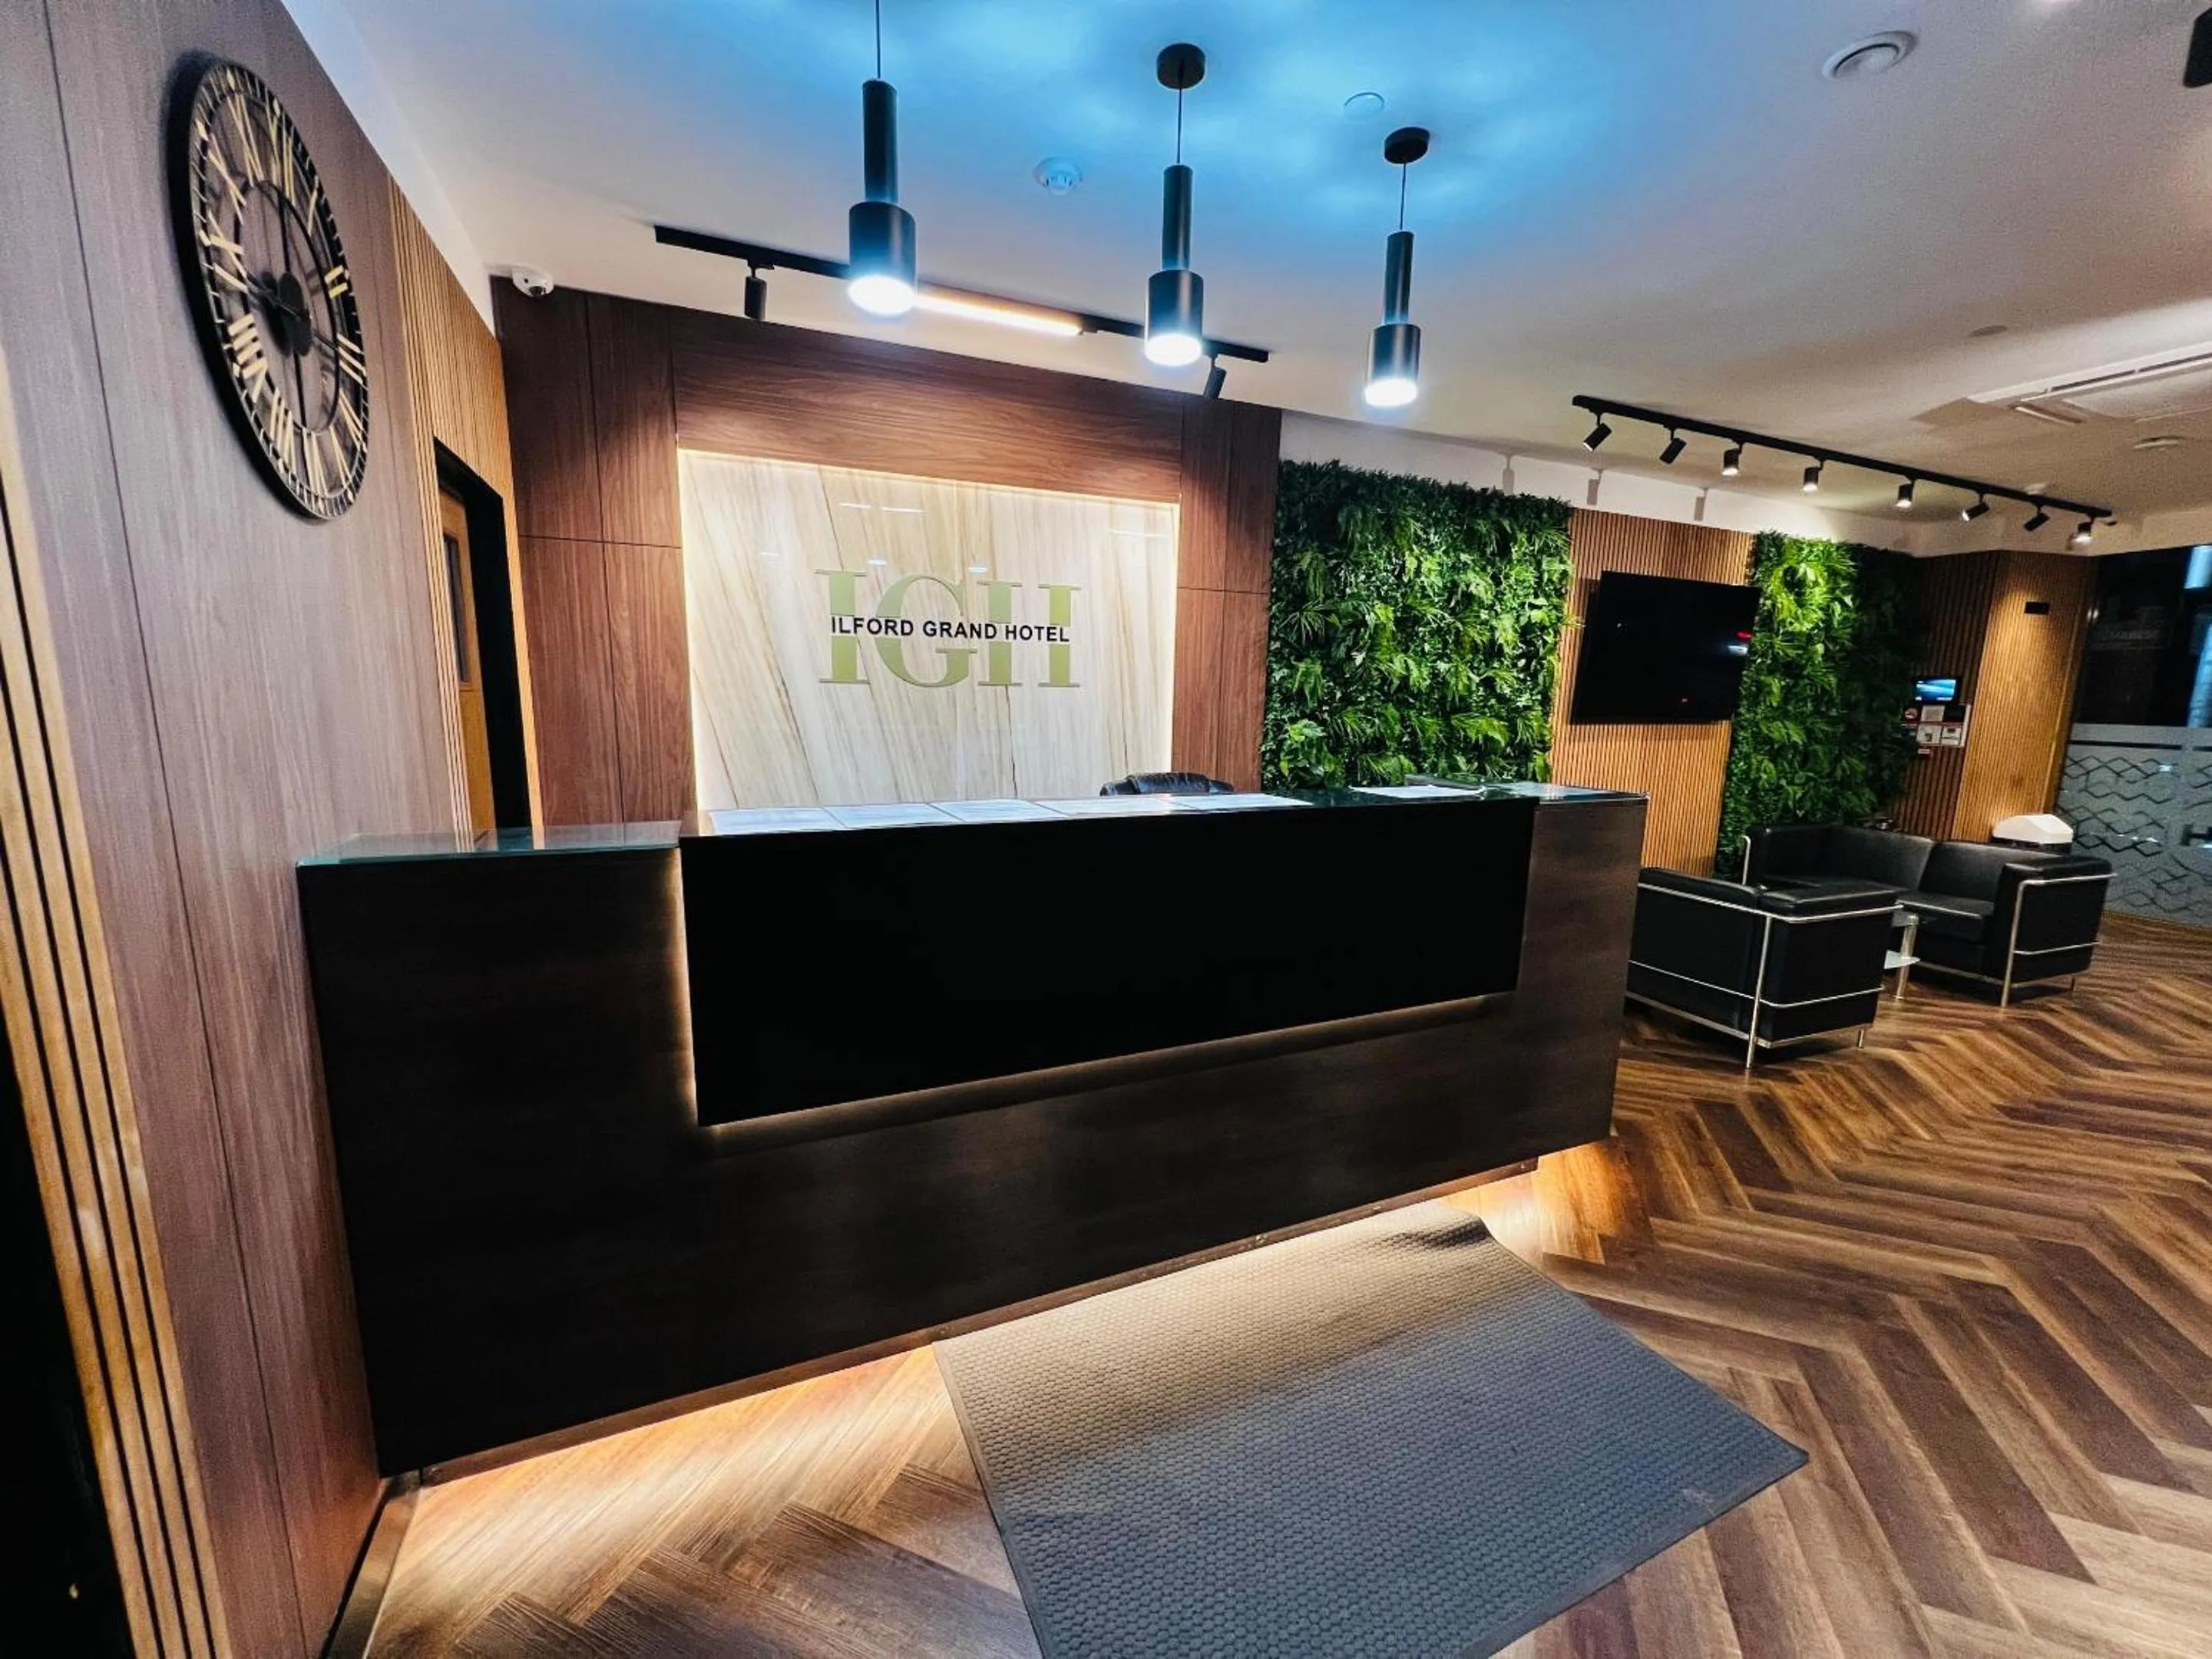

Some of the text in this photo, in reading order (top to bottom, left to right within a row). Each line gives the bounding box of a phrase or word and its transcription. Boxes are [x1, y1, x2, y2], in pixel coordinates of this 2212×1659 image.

[831, 616, 1070, 643] ILFORD GRAND HOTEL
